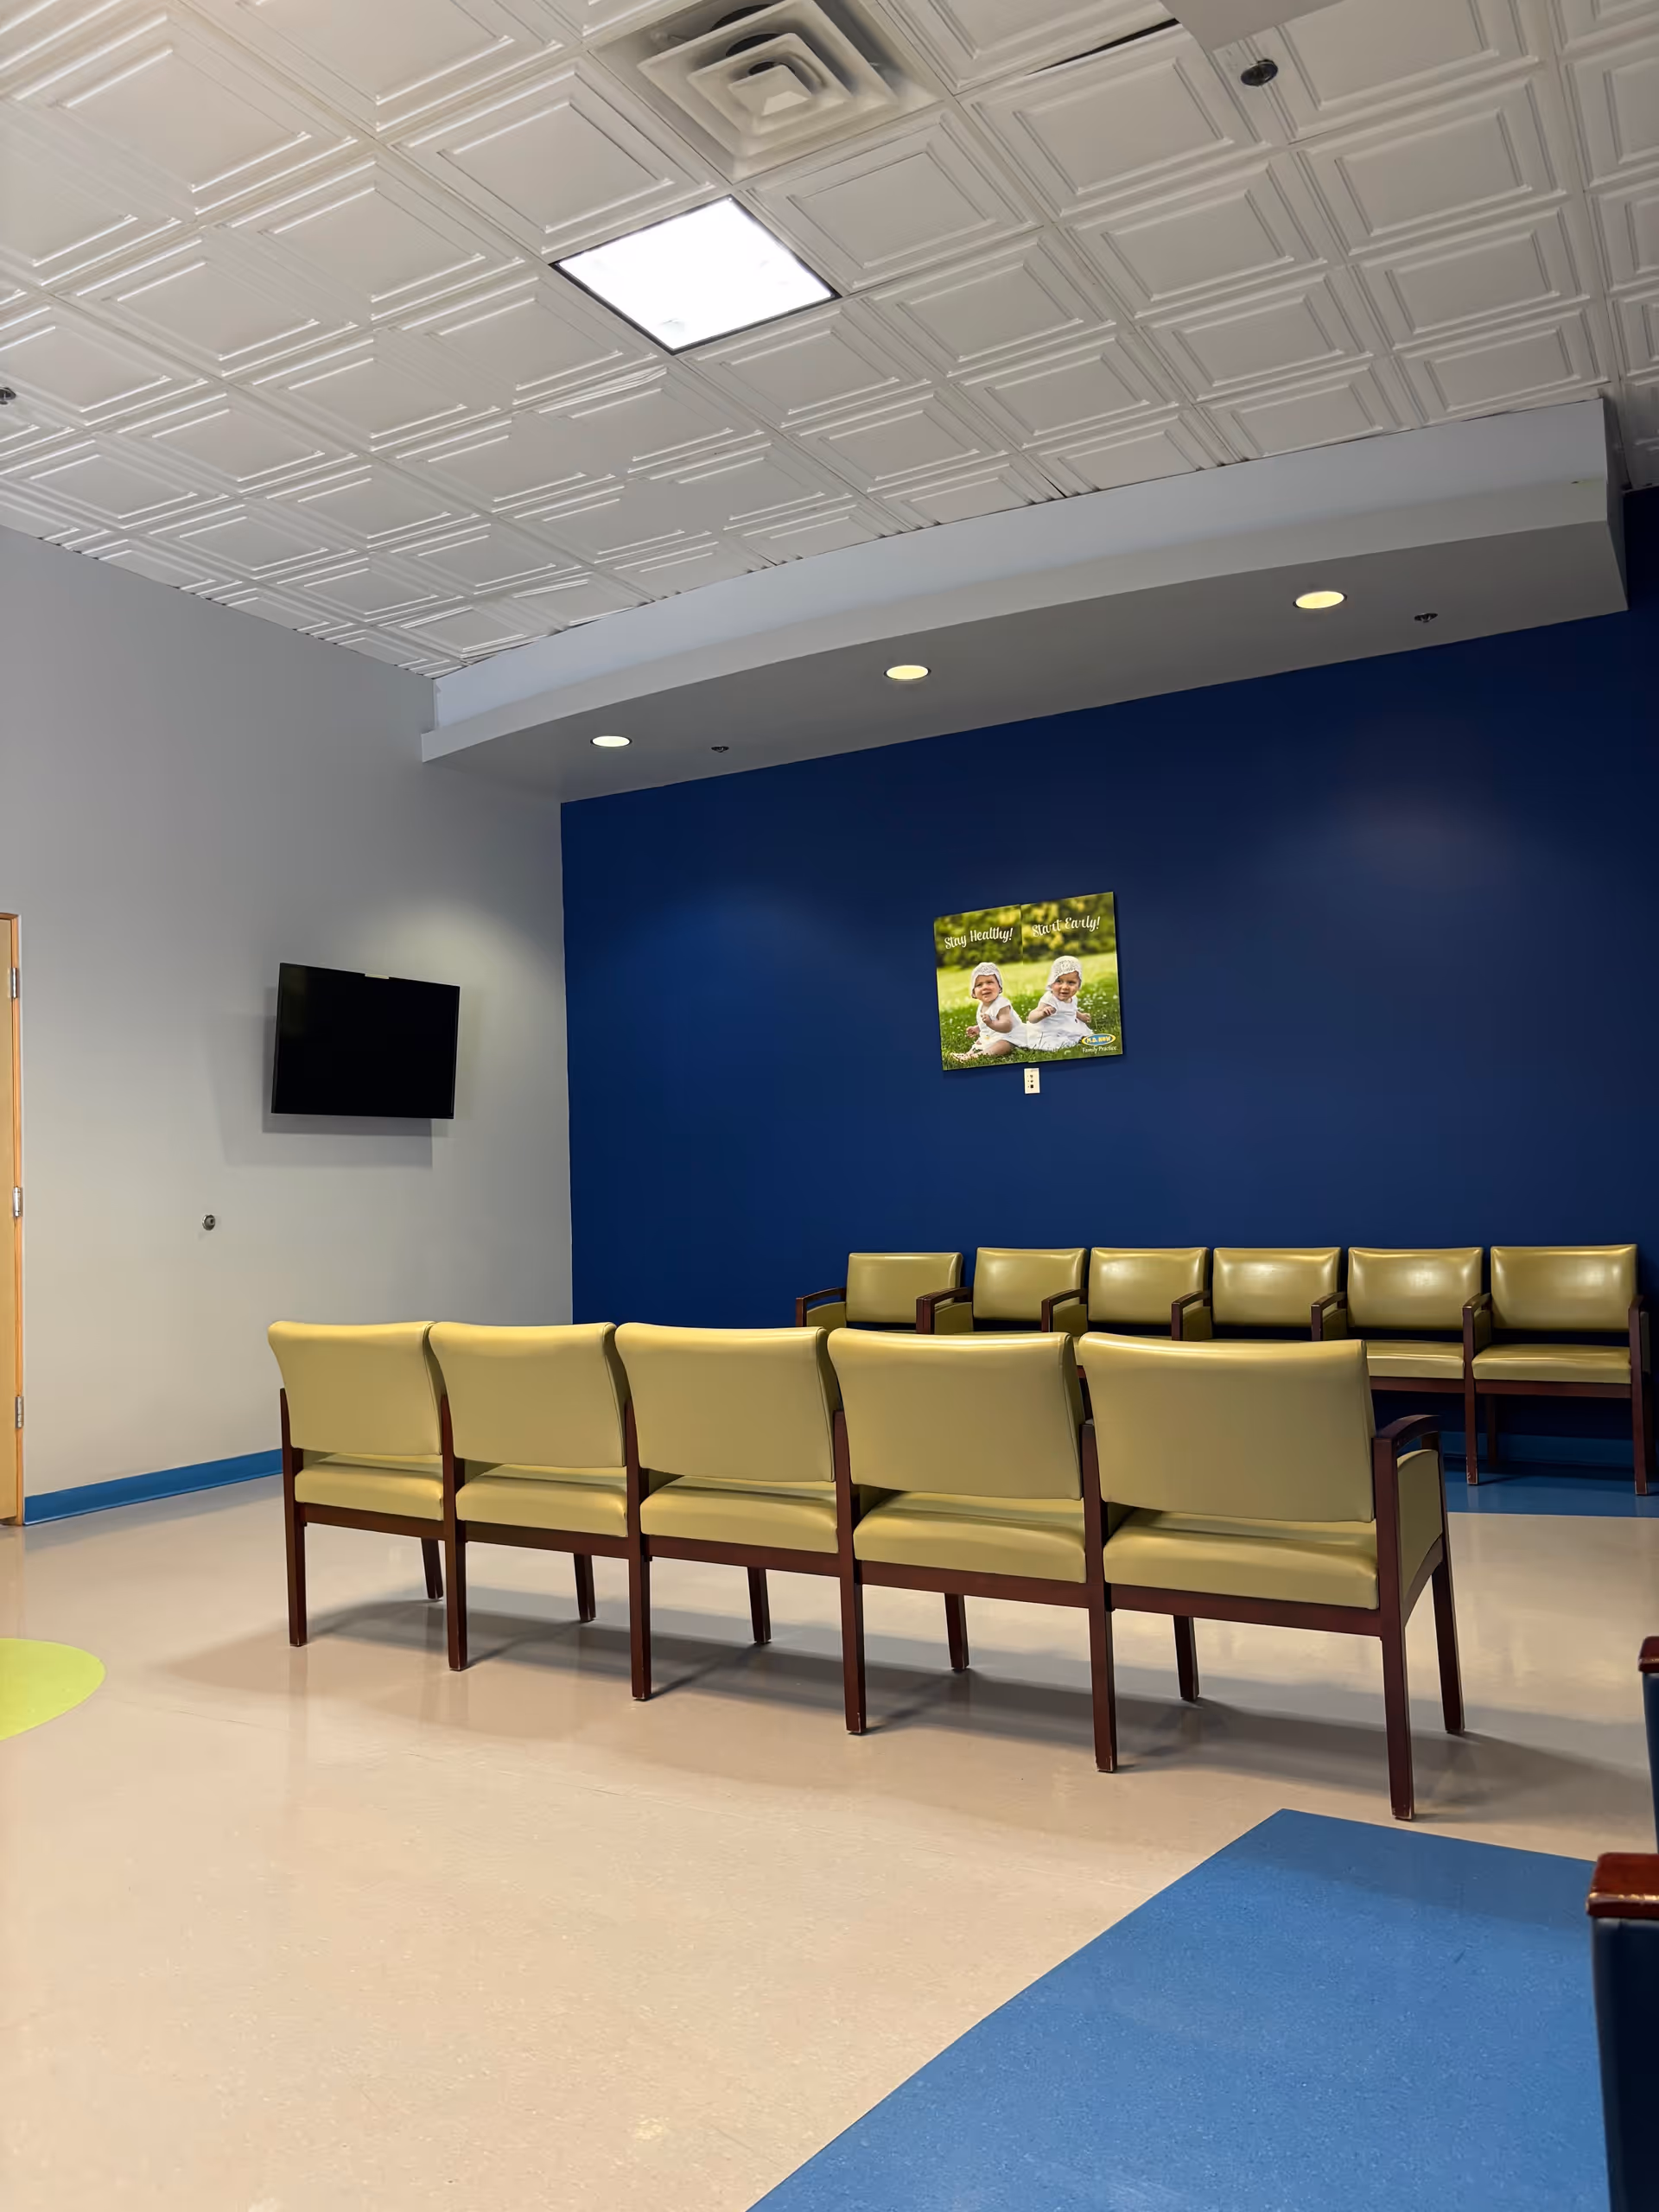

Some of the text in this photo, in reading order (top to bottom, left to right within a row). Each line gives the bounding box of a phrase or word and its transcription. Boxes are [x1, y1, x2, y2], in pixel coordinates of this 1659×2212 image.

[1032, 915, 1101, 938] Start Early!
[944, 927, 1014, 949] Stay Healthy!
